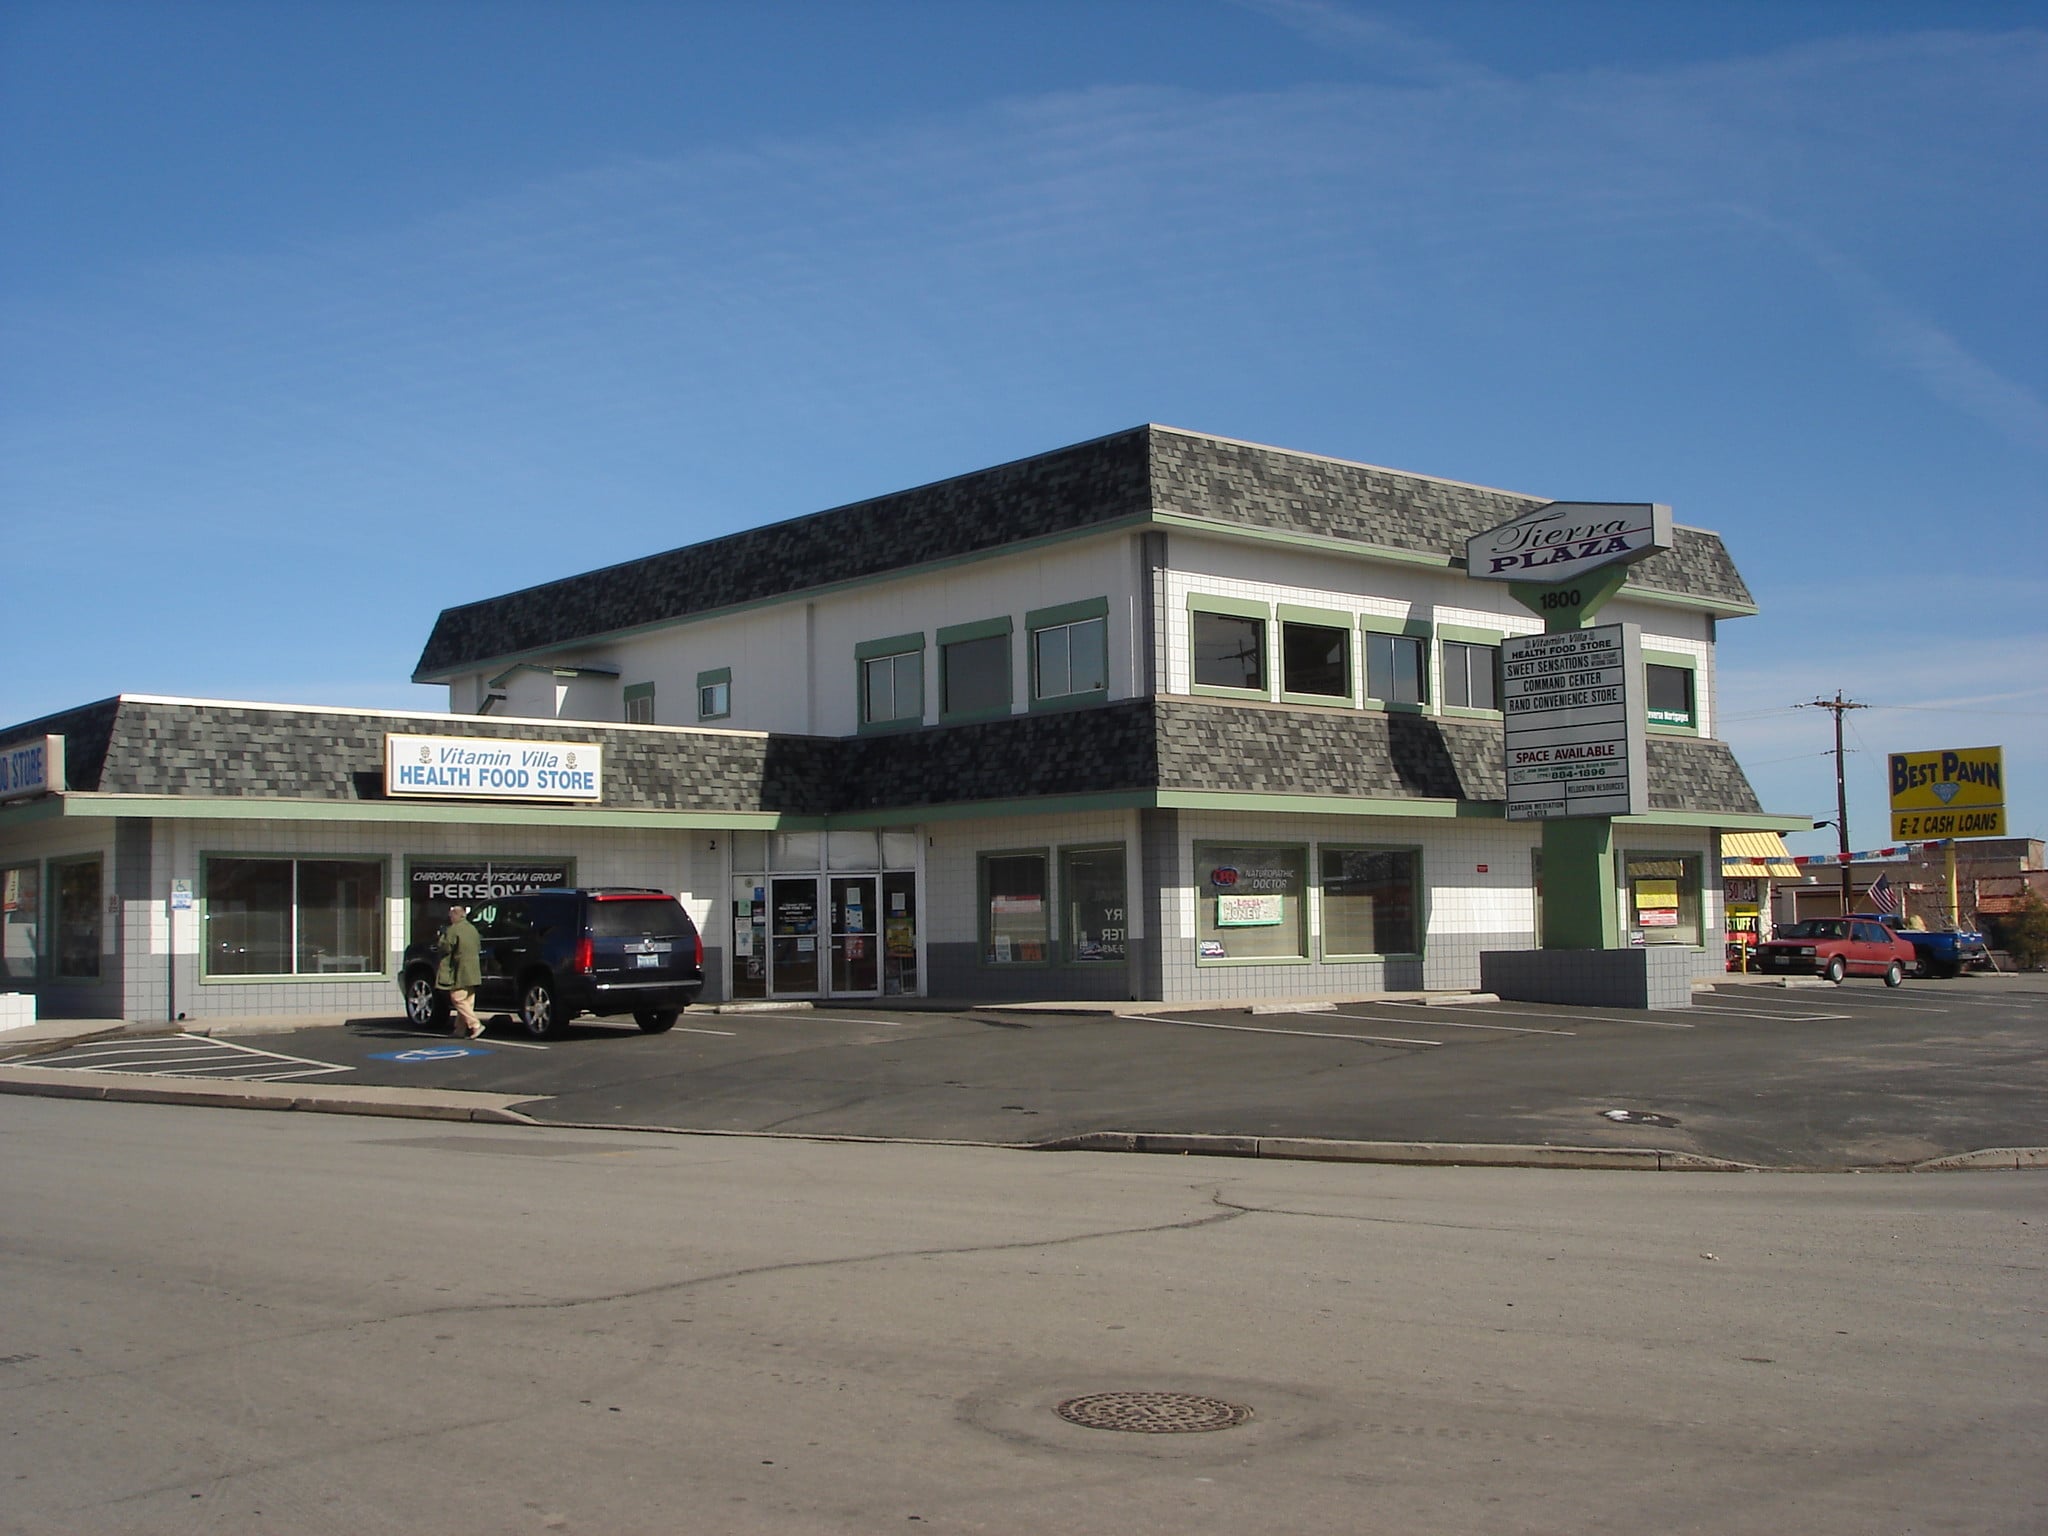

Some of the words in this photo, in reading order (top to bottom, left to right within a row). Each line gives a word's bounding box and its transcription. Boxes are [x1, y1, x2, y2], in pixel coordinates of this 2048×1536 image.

[1492, 512, 1631, 553] Tierra
[1488, 536, 1632, 574] PLAZA
[1540, 590, 1581, 610] 1800
[1512, 649, 1546, 659] HEALTH
[1550, 645, 1576, 654] FOOD
[1580, 640, 1611, 650] STORE
[1531, 637, 1565, 649] Vitamin
[1569, 633, 1588, 644] Villa
[1507, 662, 1535, 677] SWEET
[1538, 655, 1589, 672] SENSATIONS
[1523, 676, 1566, 692] COMMAND
[1568, 671, 1602, 687] CENTER
[1509, 699, 1531, 712] RAND
[1533, 691, 1588, 709] CONVENIENCE
[1591, 688, 1617, 703] STORE
[439, 748, 512, 766] Vitamin
[521, 751, 560, 768] Villa
[1516, 751, 1550, 763] SPACE
[1554, 744, 1615, 760] AVAILABLE
[12, 747, 43, 789] STORE
[400, 765, 471, 786] HEALTH
[478, 767, 530, 789] FOOD
[536, 769, 595, 790] STORE
[1899, 818, 1920, 835] E-Z
[1923, 816, 1955, 833] CASH
[1958, 813, 1998, 832] LOANS
[709, 840, 716, 850] 2
[412, 872, 480, 882] CHIROPRACTIC
[530, 873, 562, 882] GROUP
[1252, 880, 1287, 889] DOCTOR
[1223, 902, 1261, 921] HONEY
